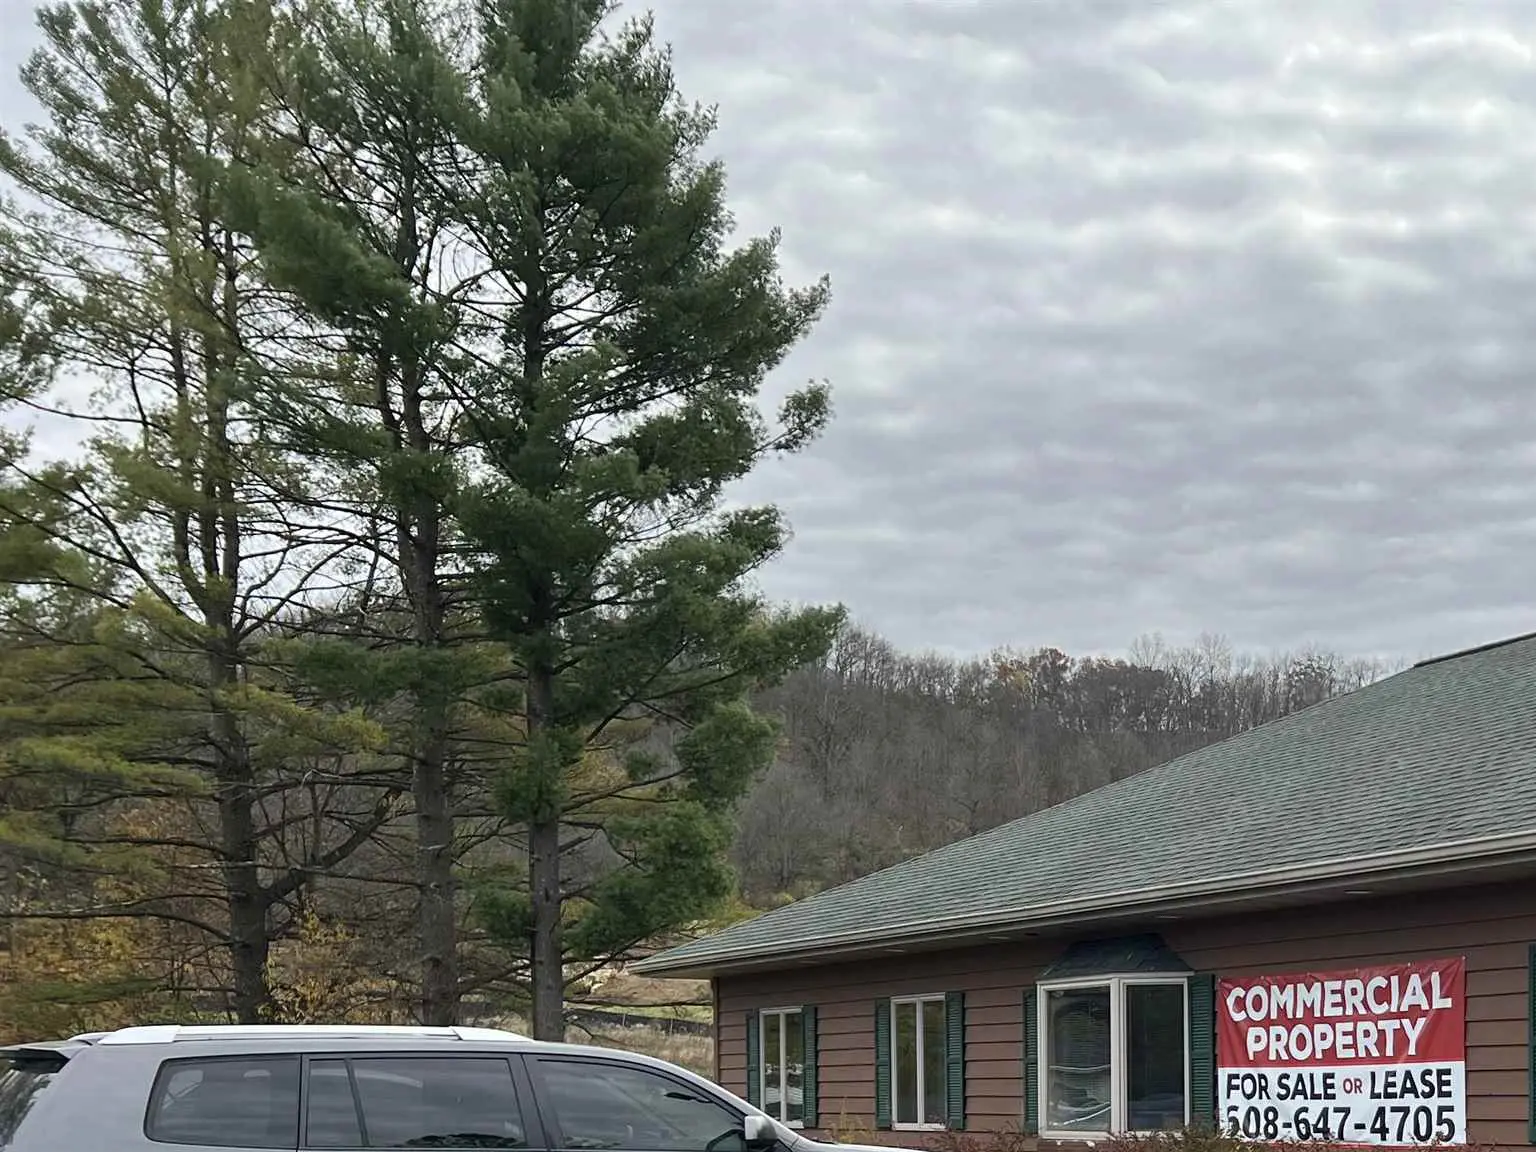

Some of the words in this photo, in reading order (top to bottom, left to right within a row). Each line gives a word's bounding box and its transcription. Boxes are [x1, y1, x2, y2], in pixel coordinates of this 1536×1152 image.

[1226, 971, 1452, 1022] COMMERCIAL
[1246, 1017, 1426, 1060] PROPERTY
[1226, 1072, 1269, 1100] FOR
[1276, 1072, 1336, 1100] SALE
[1343, 1078, 1363, 1094] OR
[1369, 1068, 1452, 1099] LEASE
